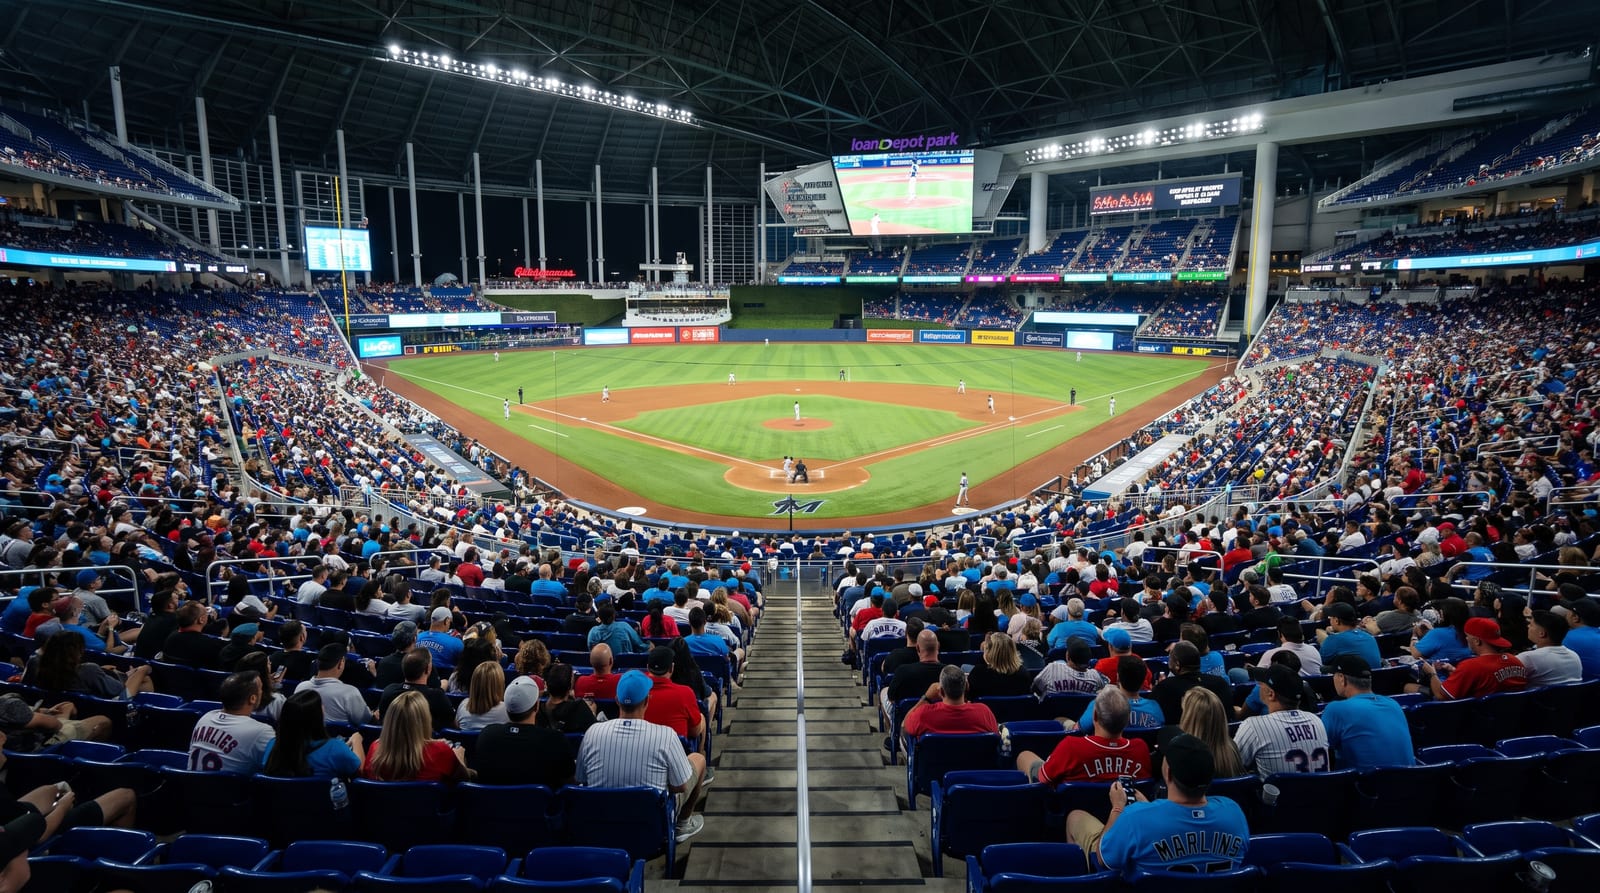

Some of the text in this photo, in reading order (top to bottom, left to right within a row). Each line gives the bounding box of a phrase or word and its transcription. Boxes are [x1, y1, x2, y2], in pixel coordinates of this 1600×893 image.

[851, 132, 960, 151] loanDepot park
[1152, 830, 1244, 862] MARLINS
